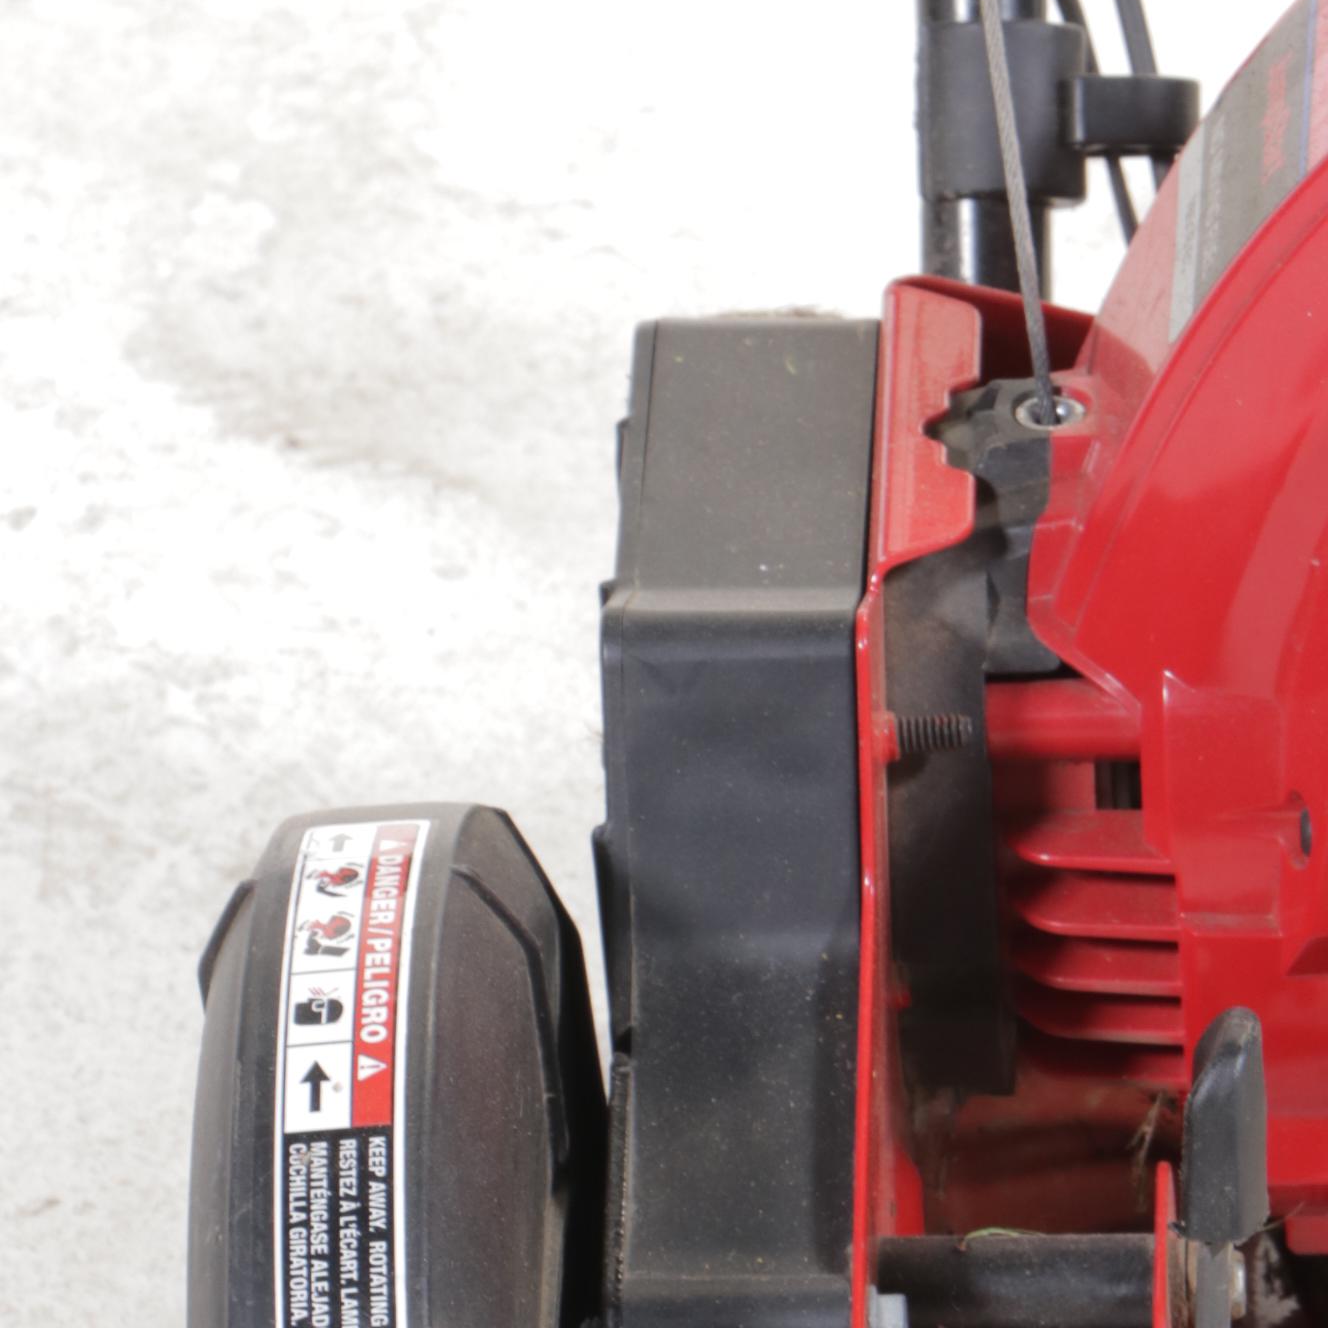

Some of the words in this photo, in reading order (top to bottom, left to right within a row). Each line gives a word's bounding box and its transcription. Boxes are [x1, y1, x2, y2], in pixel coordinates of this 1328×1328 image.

[289, 1143, 308, 1224] CUCHILLA
[339, 1139, 357, 1198] RESTEZ
[368, 1136, 386, 1178] KEEP
[310, 1141, 332, 1255] MANTÉNGASE
[339, 1201, 362, 1214] À
[368, 1181, 387, 1232] AWAY.
[289, 1227, 308, 1326] GIRATORIA.
[369, 1241, 389, 1327] ROTATING
